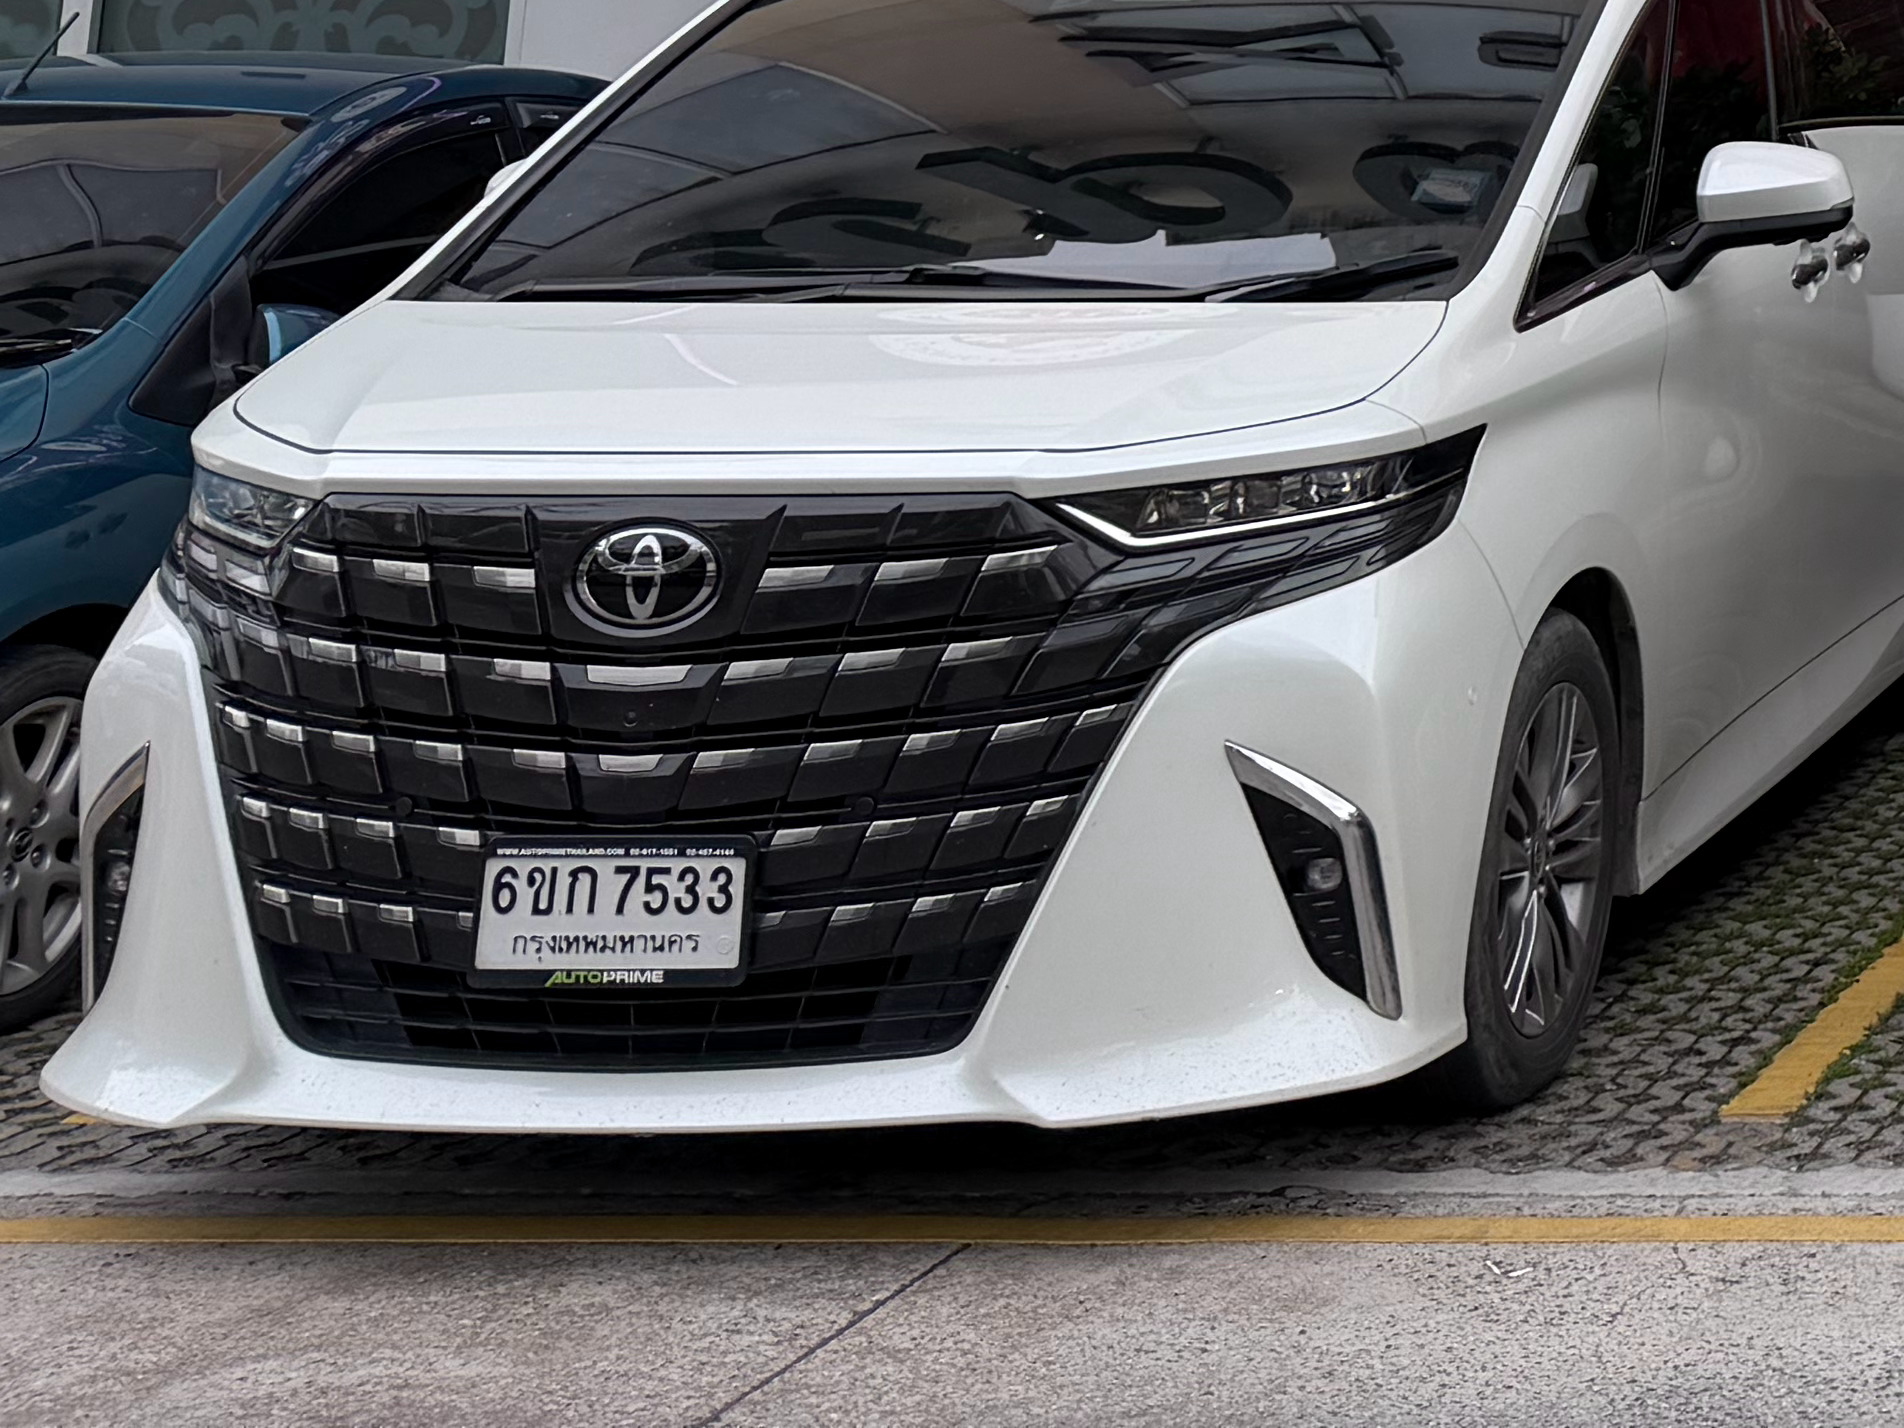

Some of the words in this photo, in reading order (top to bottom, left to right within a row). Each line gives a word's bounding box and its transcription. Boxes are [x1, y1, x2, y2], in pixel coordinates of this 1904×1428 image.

[491, 865, 600, 916] 6ขก
[613, 865, 734, 916] 7533
[511, 932, 702, 963] กรุงเทพมหานคร
[545, 969, 665, 988] AUTOPRIME
